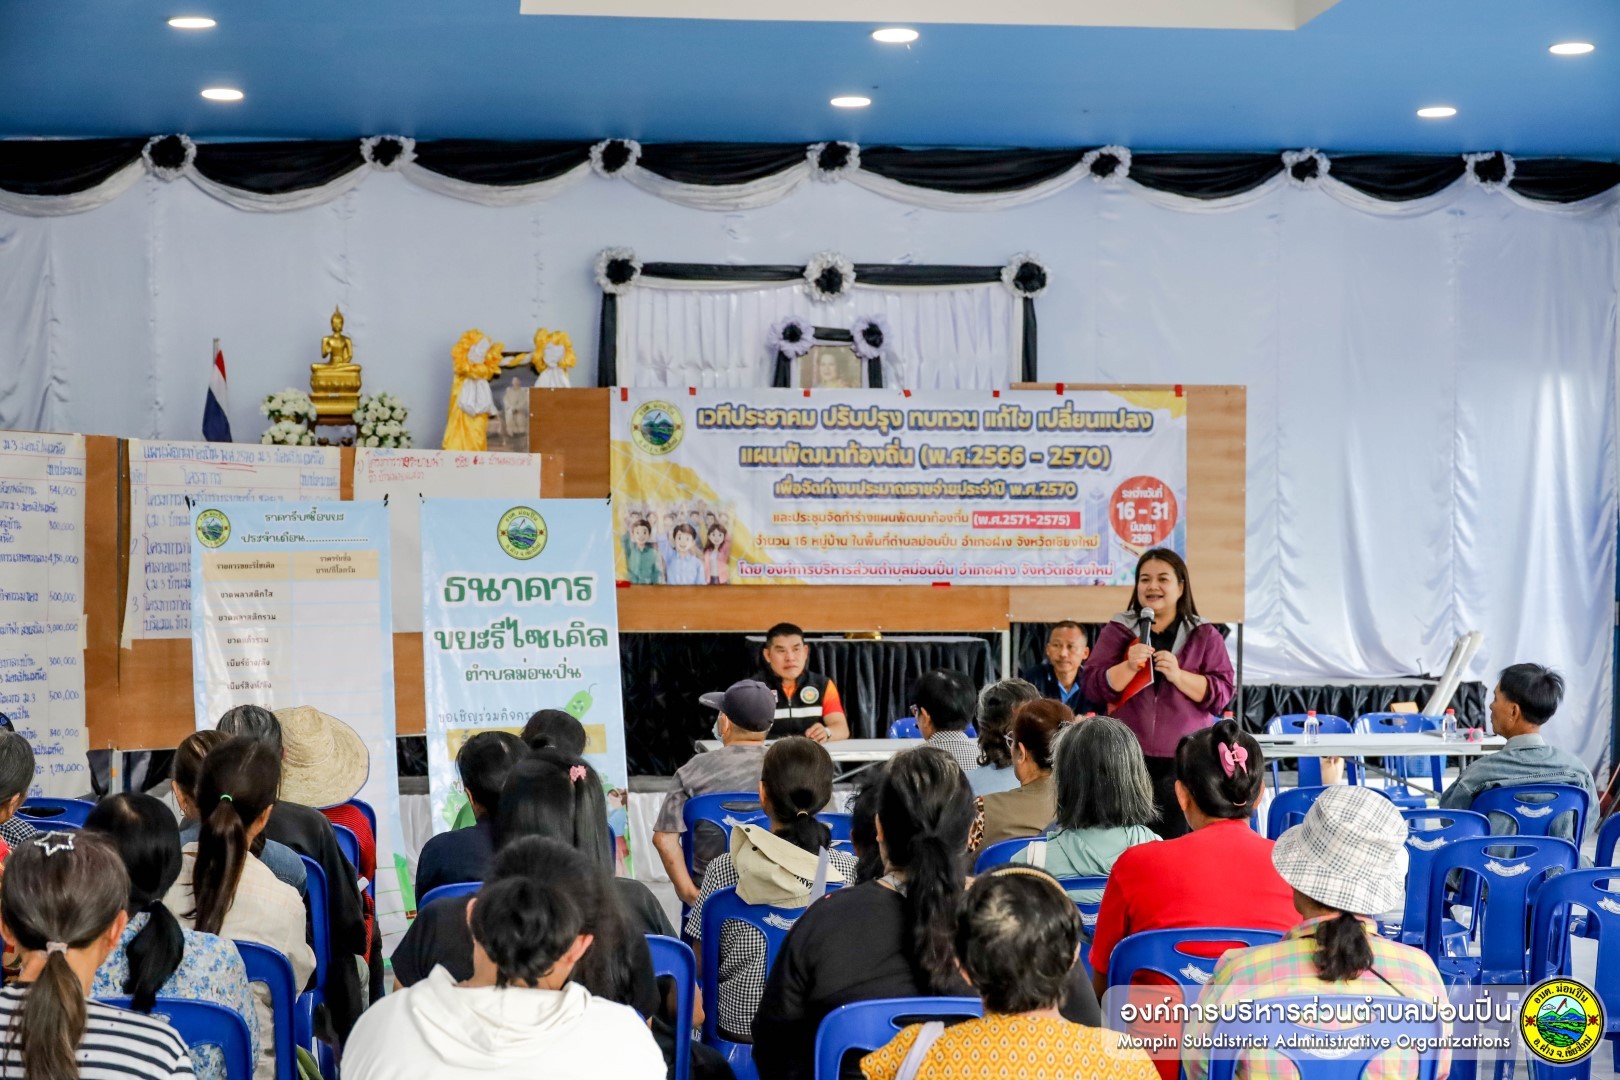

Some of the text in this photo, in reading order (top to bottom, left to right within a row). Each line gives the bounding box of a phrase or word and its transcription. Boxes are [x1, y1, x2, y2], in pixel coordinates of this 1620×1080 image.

[697, 403, 815, 429] เวทีประชาคม
[822, 403, 903, 435] ปรับปรุง
[908, 408, 978, 431] ทบทวน
[983, 404, 1032, 431] แก้ไข
[1037, 400, 1153, 431] เปลี่ยนแปลง
[740, 438, 914, 468] แผนพัฒนาท้องถิ่น
[919, 444, 1026, 470] (พ.ศ.2566
[1048, 444, 1112, 469] 2570)
[774, 474, 1078, 500] เพื่อจัดทำงบประมาณรายจ่ายประจำปี พ.ศ.2570
[264, 506, 345, 523] ราคารับซื้อขยะ
[973, 513, 1071, 527] (พ.ศ.2571-2575)
[1116, 501, 1136, 521] 16
[1150, 501, 1169, 521] 31
[756, 534, 790, 547] จำนวน
[811, 534, 848, 549] หมู่บ้าน
[961, 536, 1012, 549] อำเภอฝาง
[1016, 534, 1099, 549] จังหวัดเชียงใหม่
[738, 559, 1114, 577] โดย องค์การบริหารส่วนตำบลม่อนปิ่น อำเภอฝาง จังหวัดเชียงใหม่
[443, 576, 594, 603] ธนาคาร
[433, 616, 609, 650] ขยะรีไซเคิล
[465, 657, 582, 682] ตำบลม่อนปิ่น
